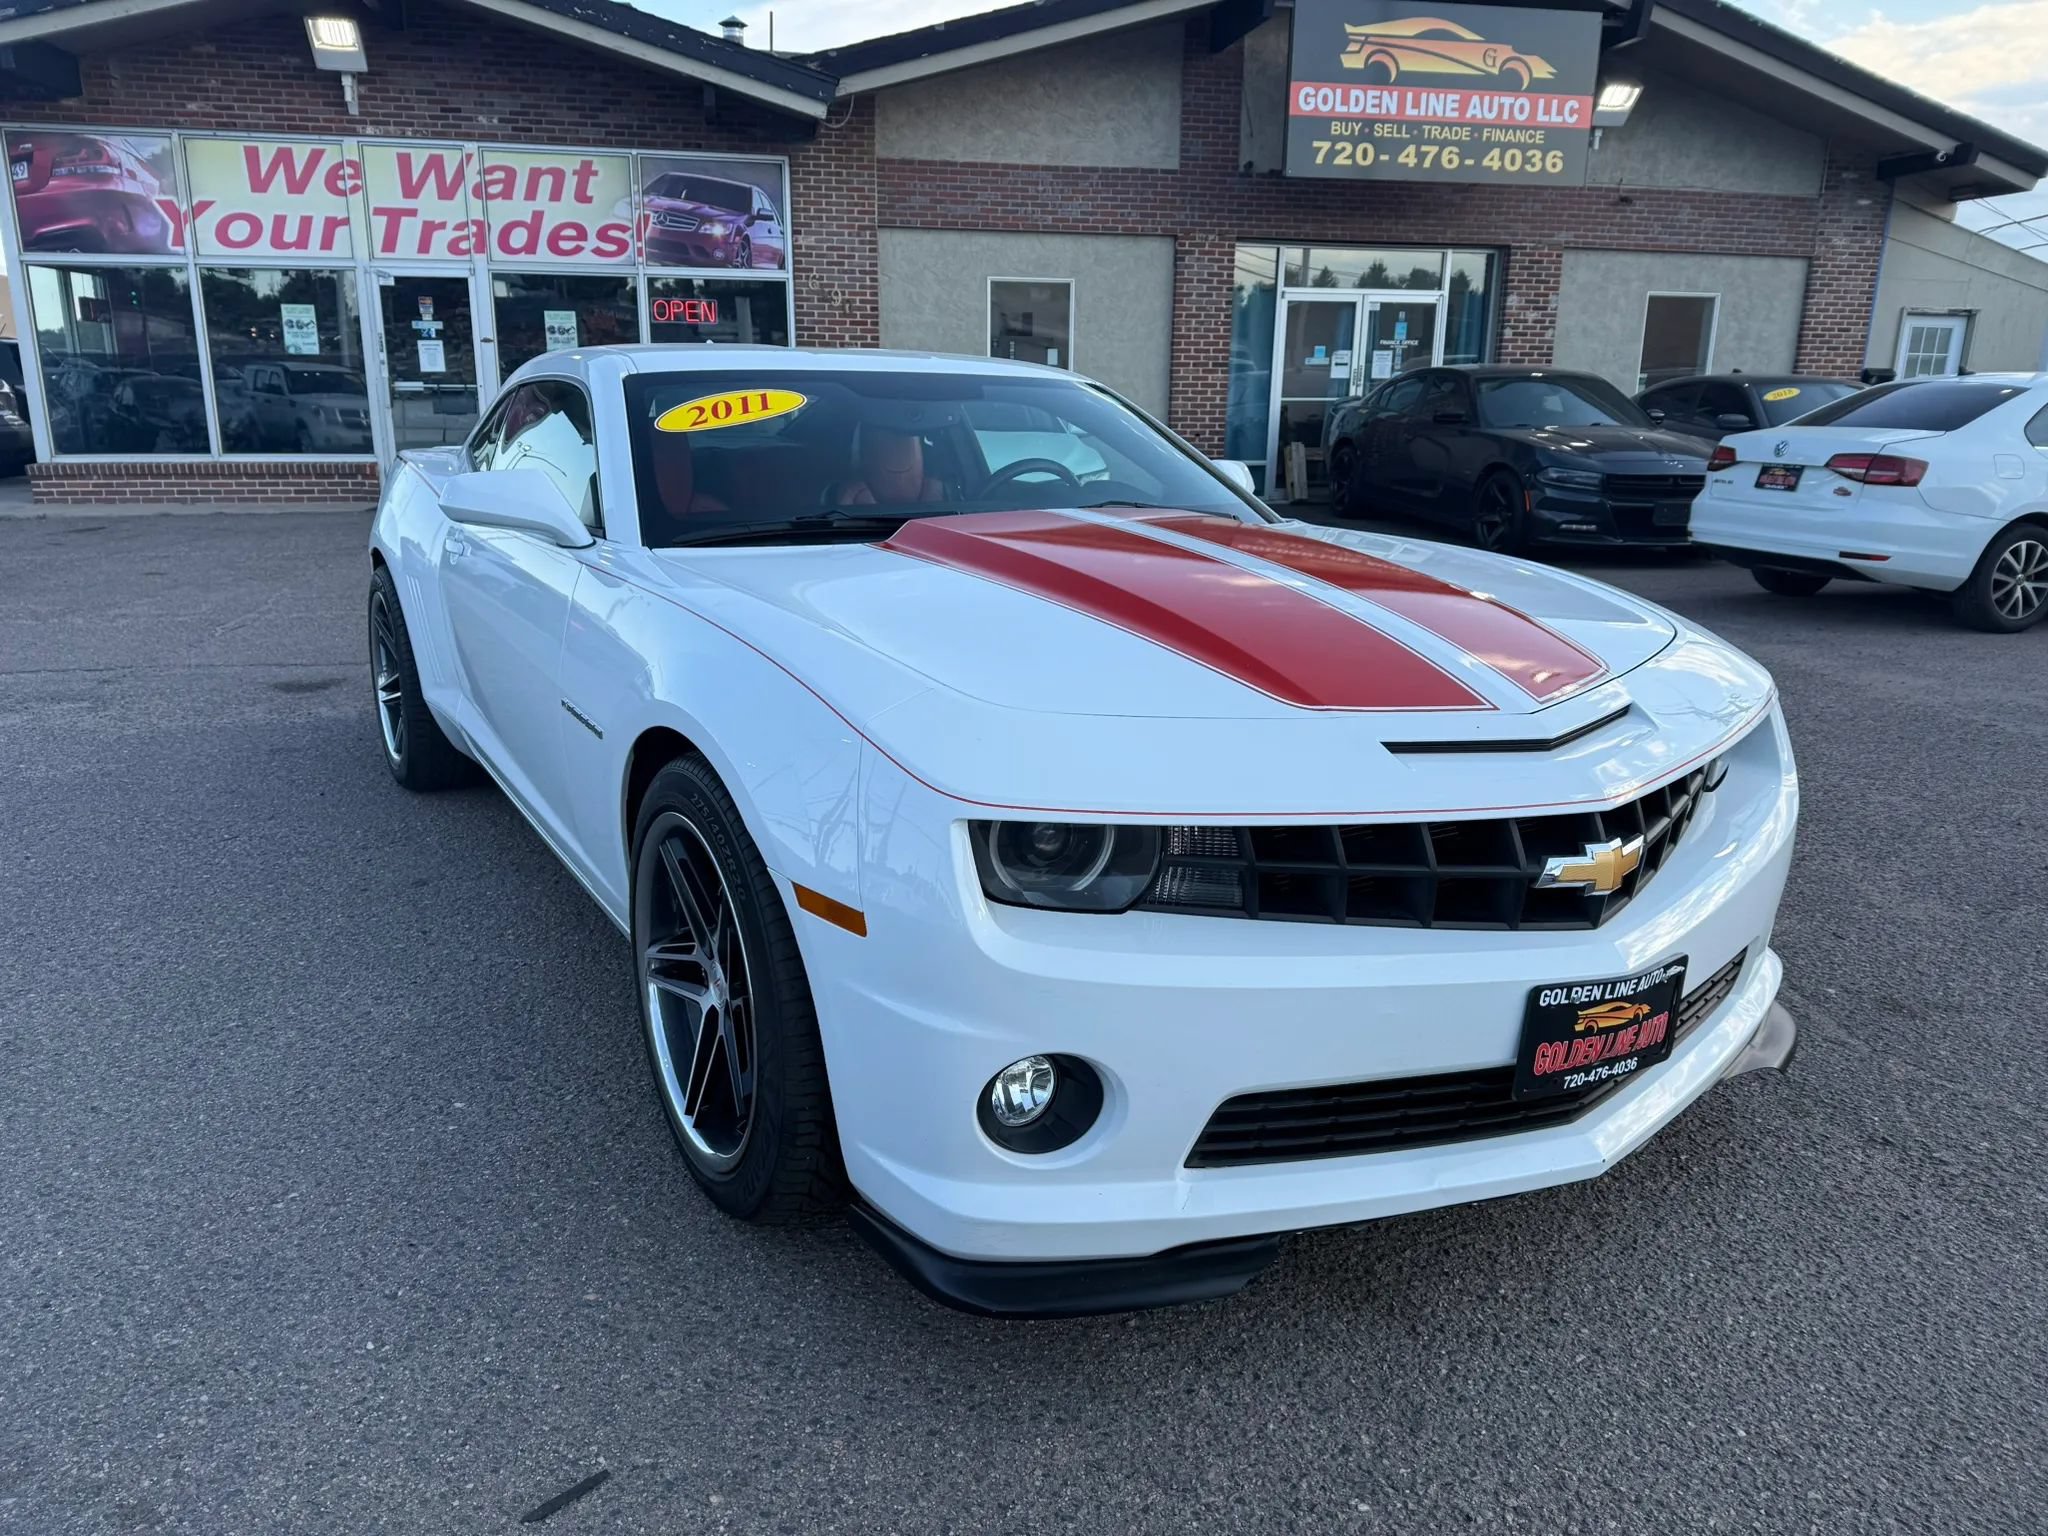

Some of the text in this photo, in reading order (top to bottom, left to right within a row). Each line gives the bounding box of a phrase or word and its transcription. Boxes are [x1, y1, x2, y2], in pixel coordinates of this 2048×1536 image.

[1298, 86, 1580, 124] GOLDEN LINE AUTO LLC
[1330, 121, 1545, 144] BUY SELL TRADE FINANCE
[242, 144, 600, 205] We Want
[155, 199, 650, 259] Your Trades!
[653, 299, 717, 324] OPEN
[686, 392, 774, 428] 2011
[1539, 968, 1664, 1007] GOLDEN LINE AUTO
[1533, 1011, 1669, 1076] GOLDEN LINE AUTO
[1563, 1057, 1638, 1089] 720-476-4036
